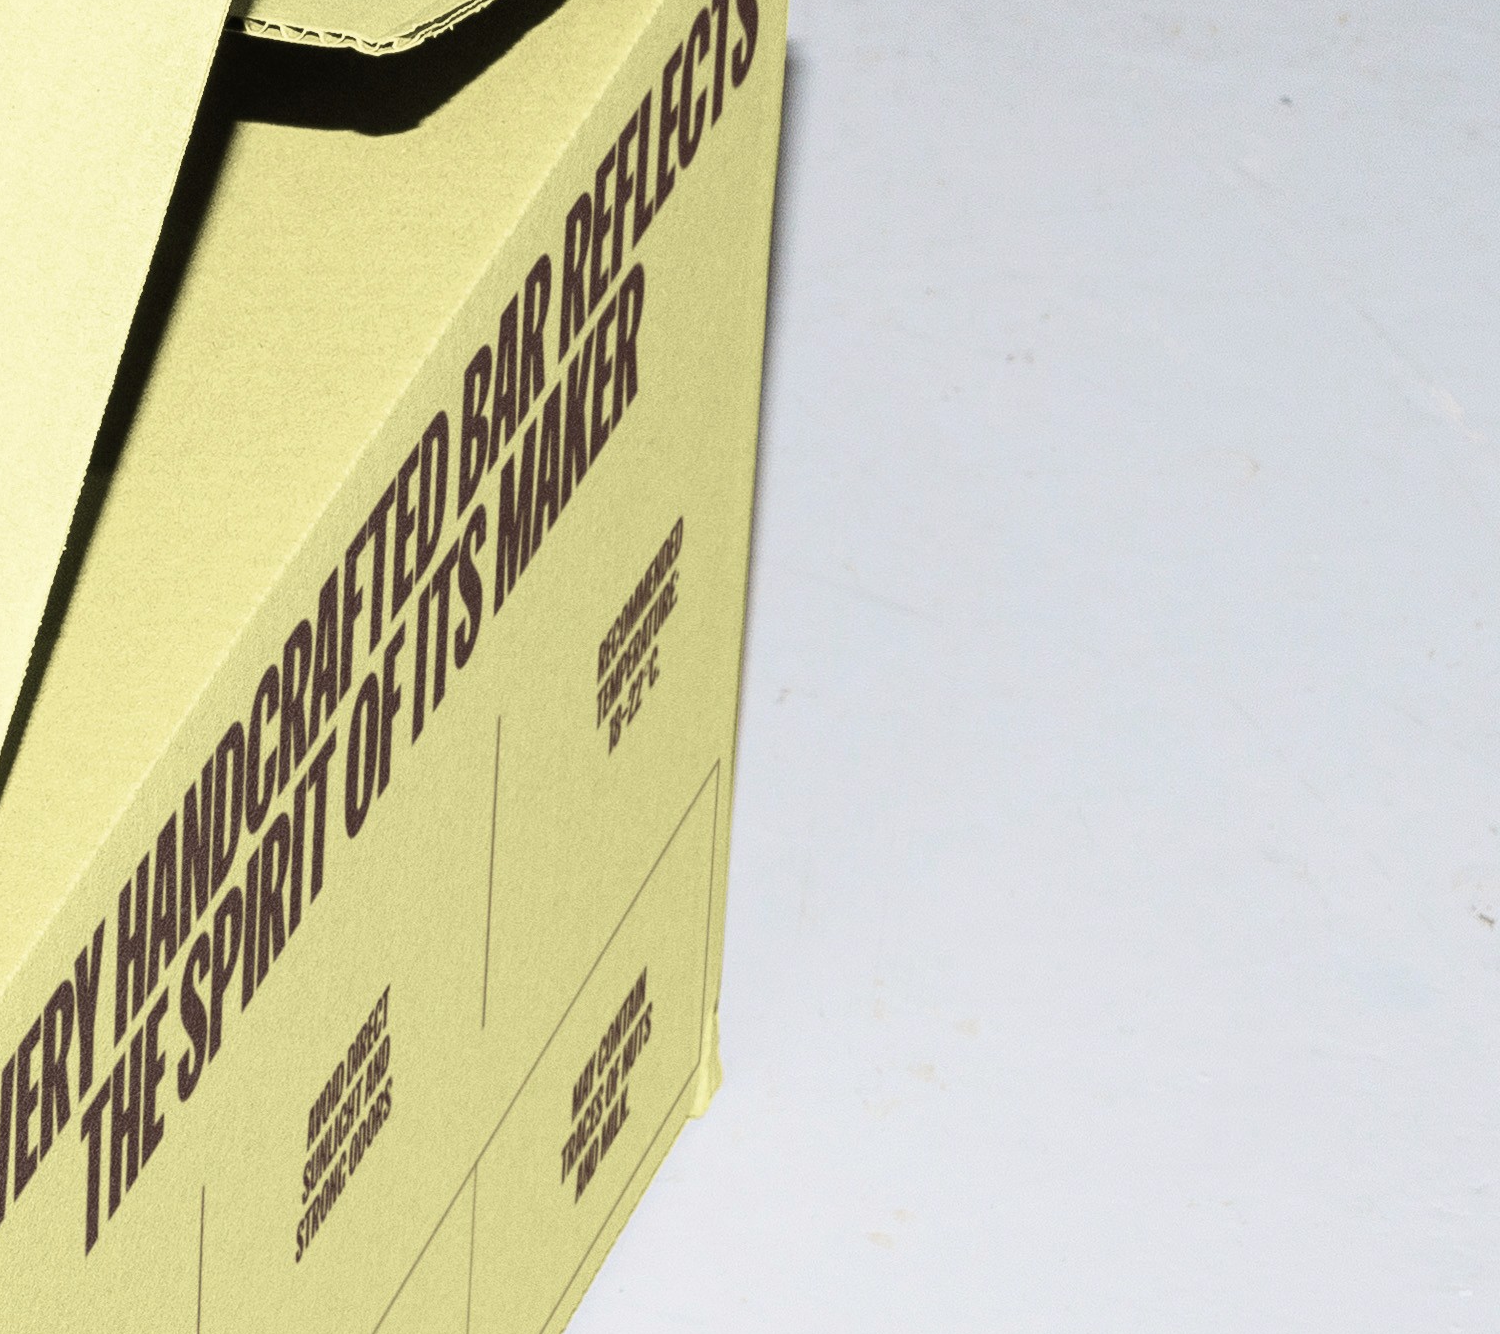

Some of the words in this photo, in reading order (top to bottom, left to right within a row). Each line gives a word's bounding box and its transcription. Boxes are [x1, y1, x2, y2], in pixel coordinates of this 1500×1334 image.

[114, 411, 449, 1047] HANDCRAFTED
[457, 254, 551, 519] BAR
[597, 517, 683, 683] RECOMMENDED
[81, 987, 168, 1256] THE
[178, 728, 336, 1102] SPIRIT
[345, 622, 405, 838] OF
[412, 504, 486, 744] ITS
[494, 263, 644, 615] MAKER
[302, 1076, 363, 1204] SUNLIGHT
[364, 1035, 390, 1104] AND
[307, 1061, 344, 1151] AVOID
[346, 985, 390, 1087] DIRECT
[562, 1084, 604, 1183] TRACES
[605, 1055, 620, 1107] OF
[622, 1002, 652, 1081] NUTS
[572, 1053, 596, 1121] MAY
[598, 968, 646, 1077] CONTAIN
[296, 1151, 347, 1263] STRONG
[349, 1077, 392, 1175] ODORS
[575, 1137, 599, 1202] AND
